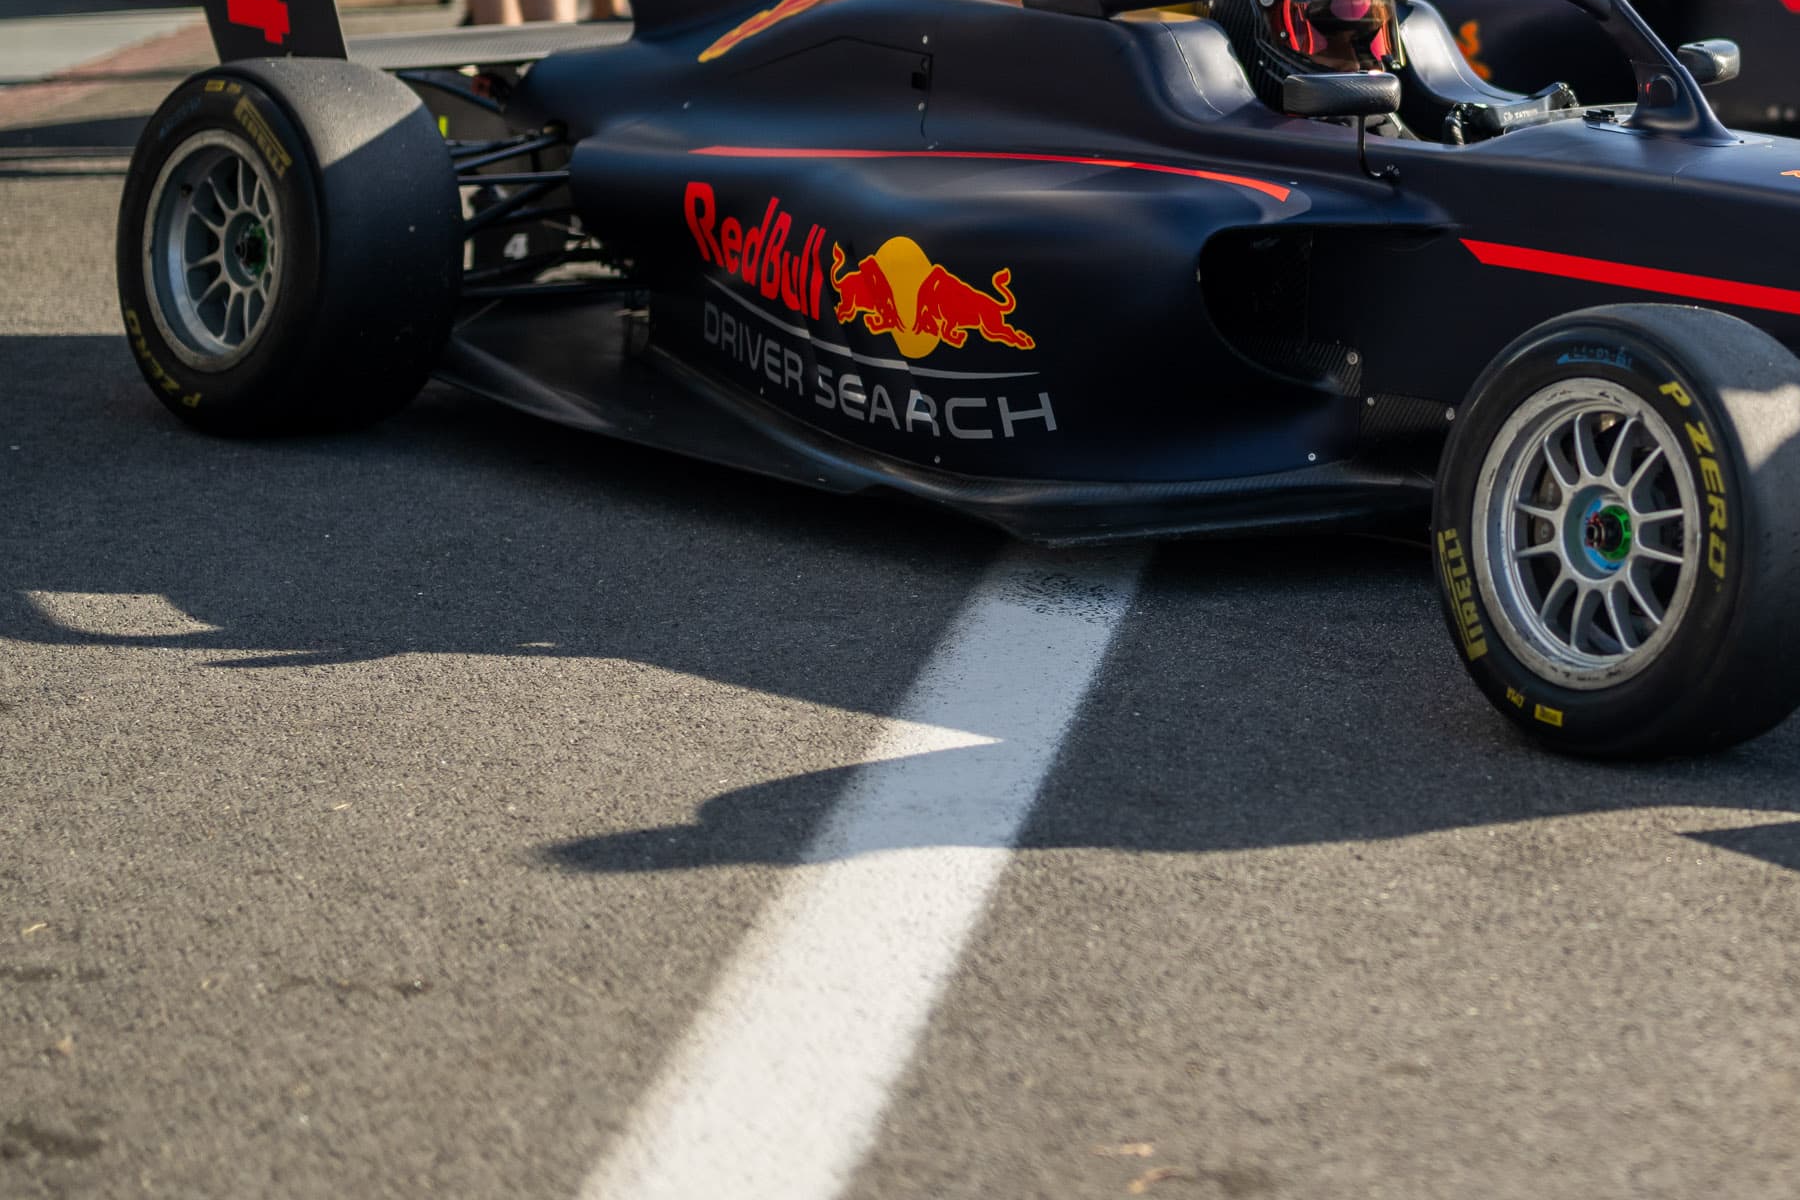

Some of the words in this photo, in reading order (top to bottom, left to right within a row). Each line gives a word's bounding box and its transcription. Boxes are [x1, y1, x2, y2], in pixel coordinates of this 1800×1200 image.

[503, 232, 528, 260] 4
[703, 301, 804, 397] DRIVER
[814, 363, 1058, 440] SEARCH
[1659, 381, 1692, 408] P
[1684, 420, 1727, 582] ZERO
[1436, 527, 1489, 662] PIRELLI
